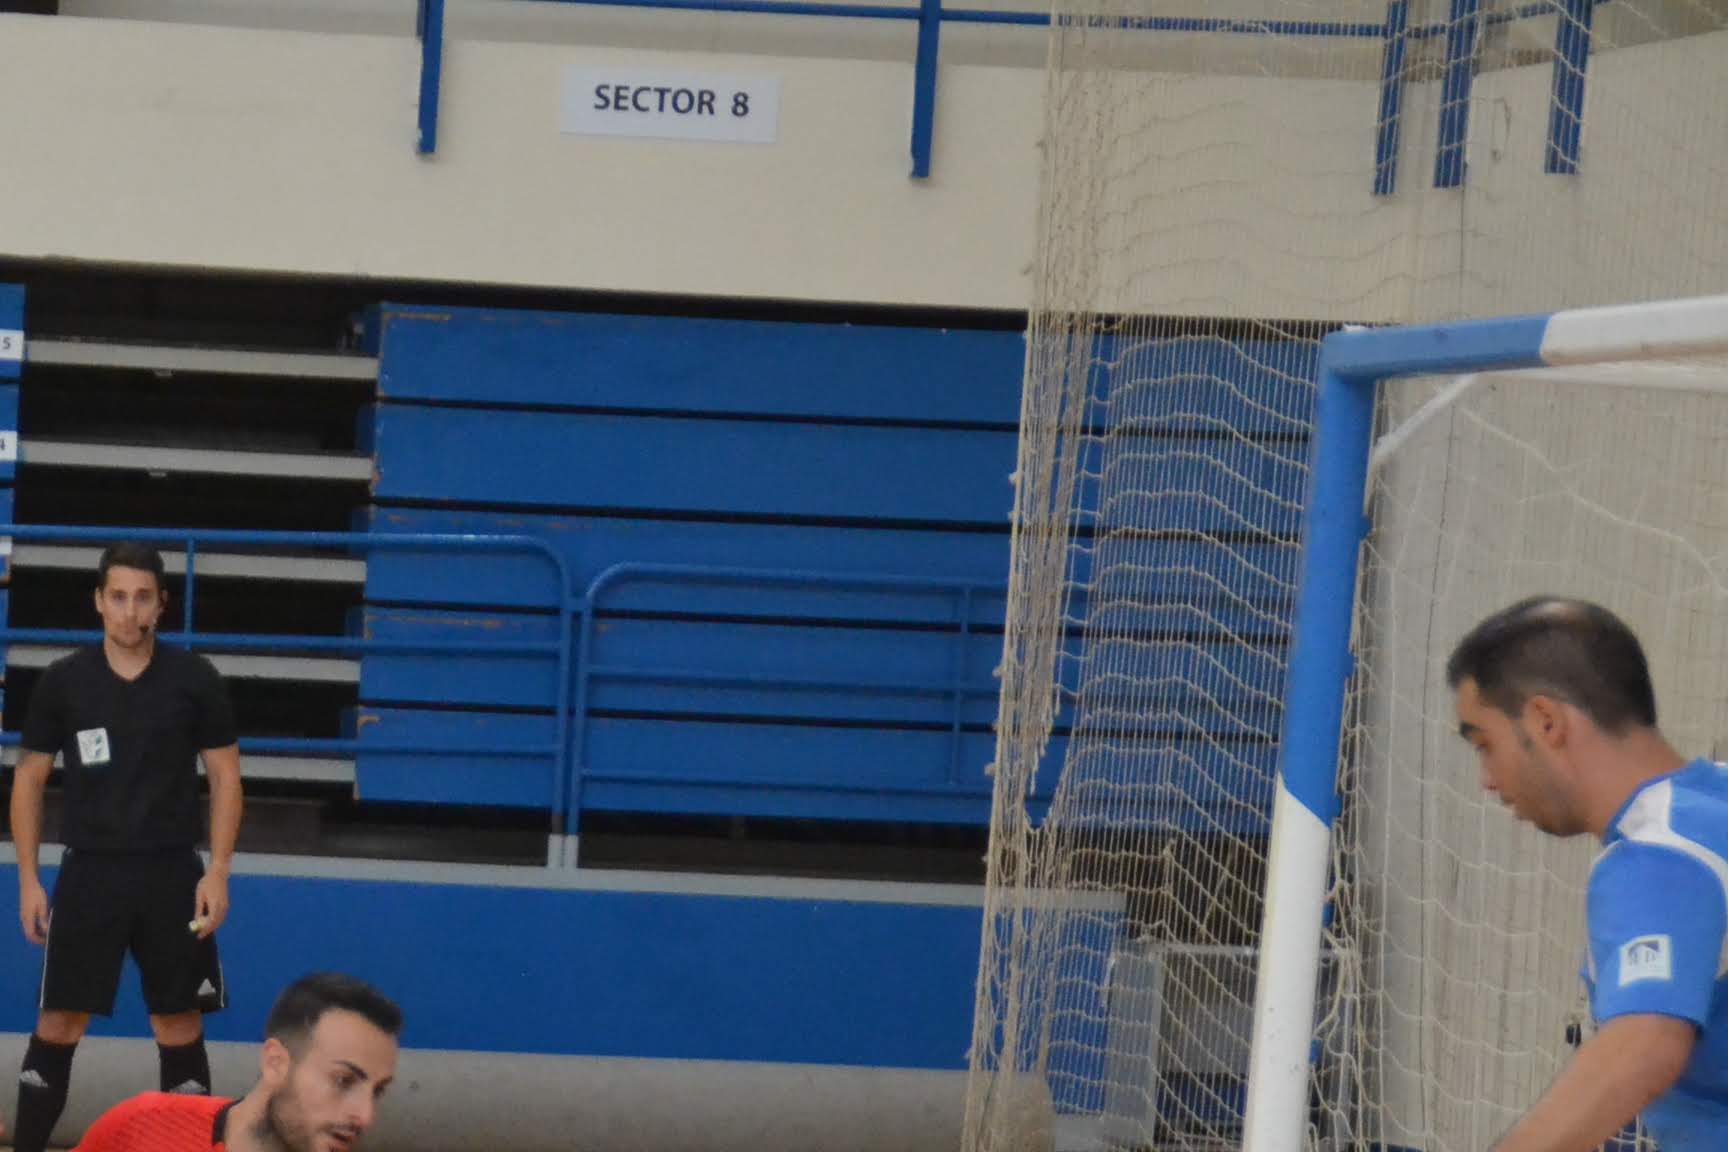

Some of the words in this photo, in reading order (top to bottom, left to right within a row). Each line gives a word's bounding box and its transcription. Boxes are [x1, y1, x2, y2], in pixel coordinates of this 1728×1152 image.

[593, 83, 716, 116] SECTOR
[730, 91, 750, 118] 8
[2, 336, 11, 350] 5
